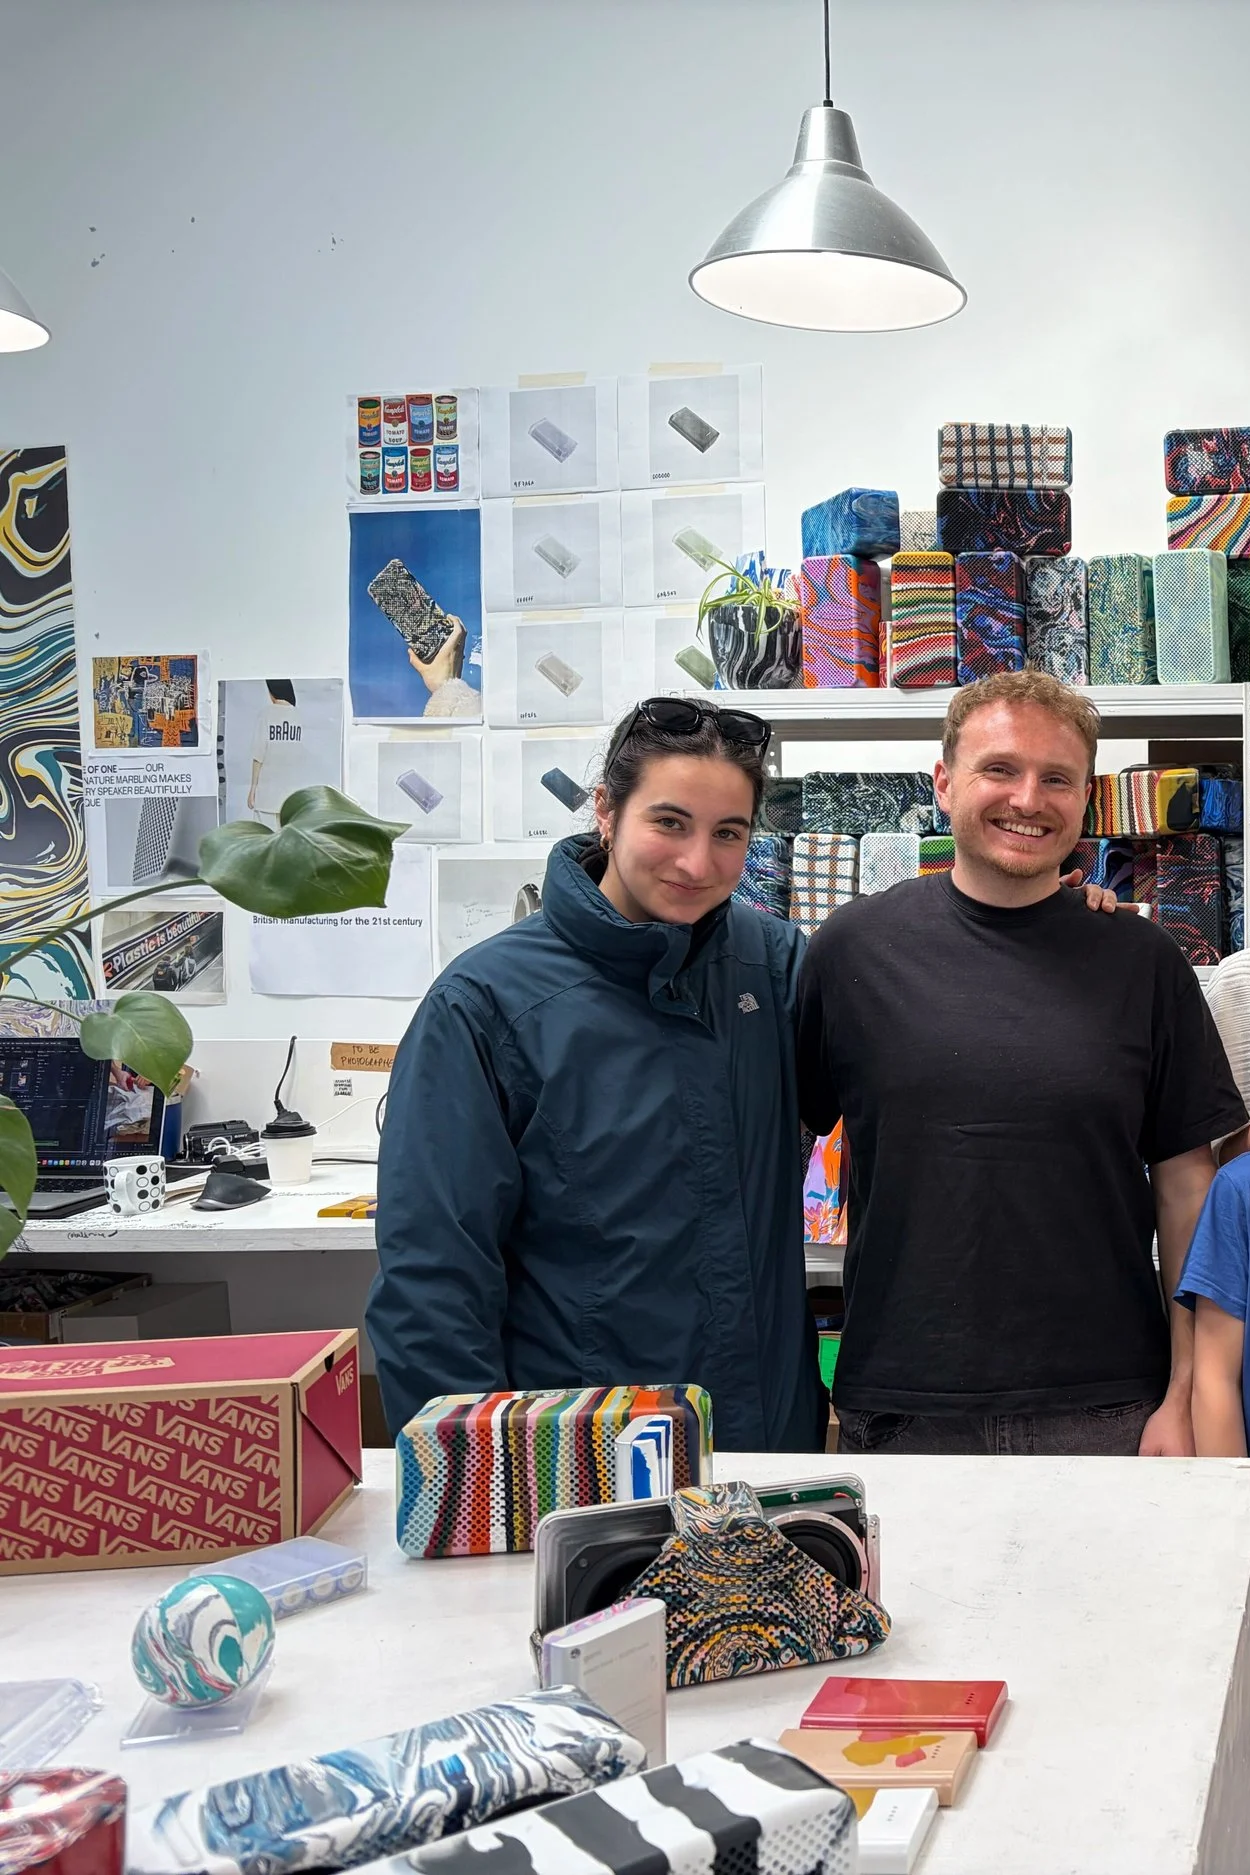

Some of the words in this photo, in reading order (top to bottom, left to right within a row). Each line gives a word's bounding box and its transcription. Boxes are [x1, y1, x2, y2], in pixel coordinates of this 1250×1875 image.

[87, 765, 99, 774] OF
[100, 765, 117, 774] ONE
[145, 763, 164, 772] OUR
[97, 786, 133, 795] SPEAKER
[134, 785, 192, 794] BEAUTIFULLY
[116, 775, 157, 784] MARBLING
[159, 773, 191, 783] MAKES
[252, 915, 278, 924] British
[280, 916, 338, 927] manufacturing
[340, 917, 352, 925] for
[355, 916, 369, 925] the
[372, 917, 391, 925] 21st
[392, 917, 423, 927] century
[112, 939, 156, 972] Plastic
[156, 933, 166, 948] is
[352, 1045, 363, 1054] TO
[368, 1045, 380, 1054] BE
[335, 1360, 354, 1396] VANS
[22, 1407, 97, 1442] VANS
[155, 1408, 230, 1456] VANS
[208, 1398, 279, 1440] VANS
[48, 1440, 123, 1487] VANS
[102, 1424, 176, 1471] VANS
[0, 1456, 69, 1503] VANS
[127, 1468, 201, 1516] VANS
[179, 1452, 253, 1500] VANS
[19, 1500, 95, 1548] VANS
[73, 1484, 148, 1532] VANS
[204, 1496, 278, 1544] VANS
